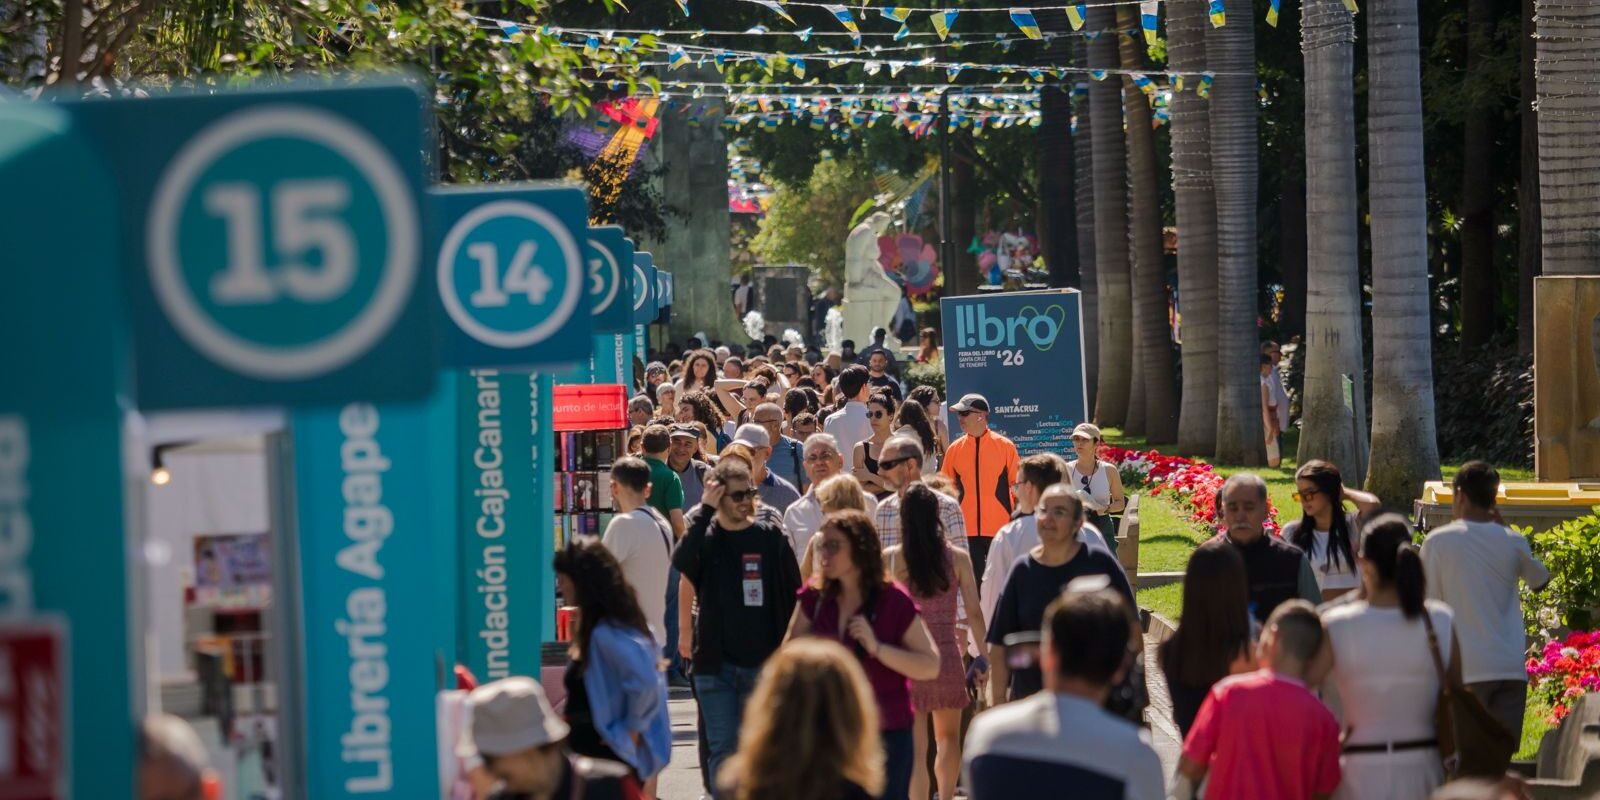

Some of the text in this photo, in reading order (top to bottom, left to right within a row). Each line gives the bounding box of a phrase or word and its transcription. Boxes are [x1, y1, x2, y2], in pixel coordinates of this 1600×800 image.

[202, 180, 357, 304] 15
[468, 240, 553, 307] 14
[588, 259, 605, 295] 3
[469, 369, 511, 538] CajaCanari
[584, 402, 595, 412] de
[334, 402, 395, 793] Librería Agape
